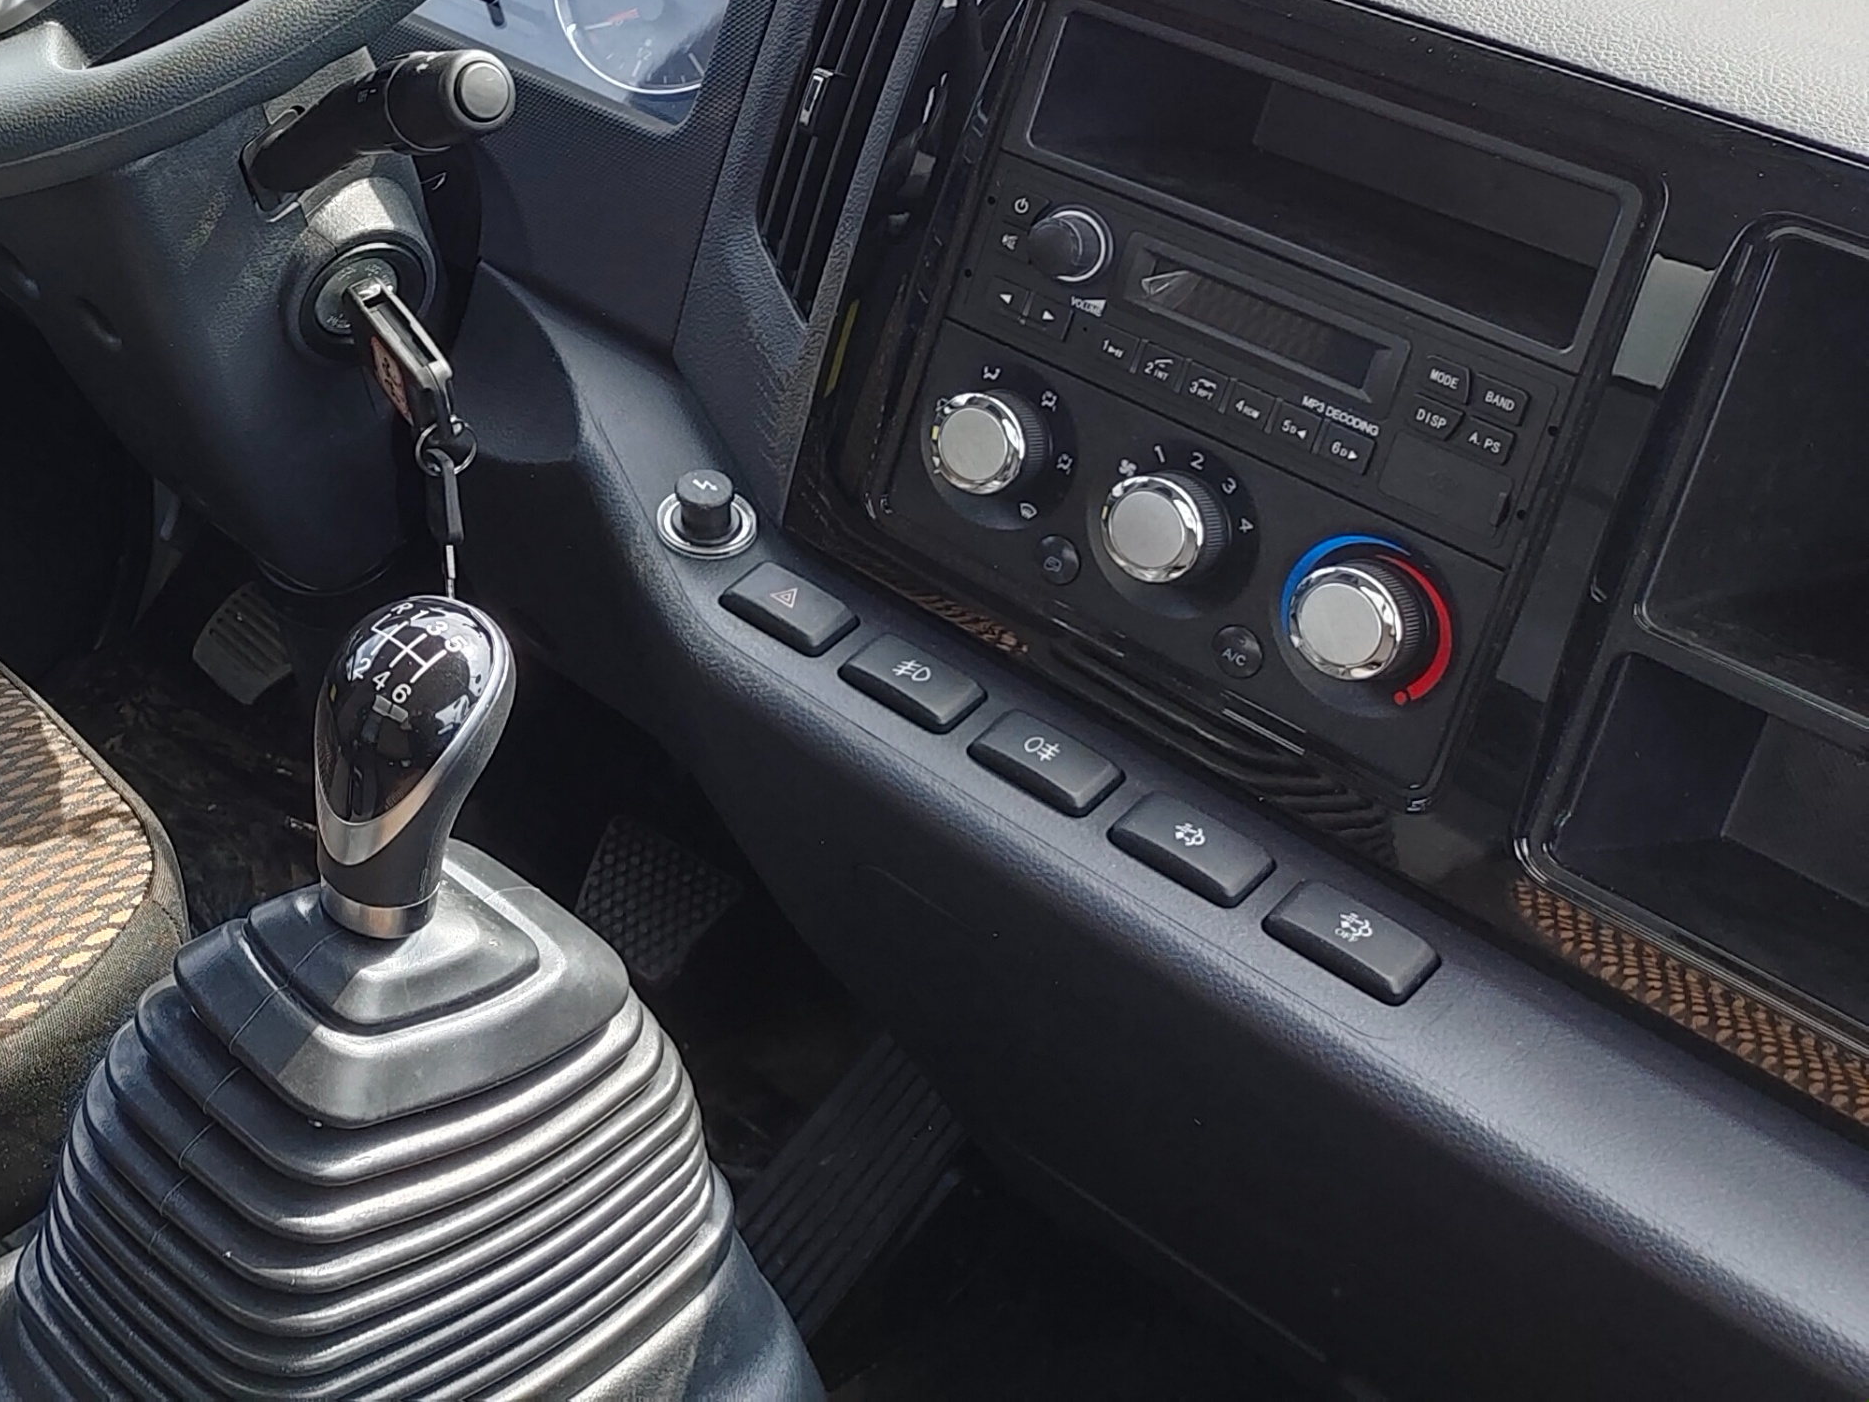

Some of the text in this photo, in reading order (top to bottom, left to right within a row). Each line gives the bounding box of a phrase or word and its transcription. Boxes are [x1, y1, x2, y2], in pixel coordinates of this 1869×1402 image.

[1071, 296, 1102, 317] VOLUME
[1144, 362, 1170, 381] 2 INT
[1430, 368, 1459, 390] MODE
[1188, 380, 1198, 394] 3
[1235, 399, 1244, 413] 4
[1484, 390, 1515, 411] BAND
[1301, 395, 1379, 437] MP3 DECODING
[1416, 408, 1447, 429] DISP
[1154, 445, 1166, 463] 1
[1190, 452, 1205, 470] 2
[1221, 477, 1237, 494] 3
[1239, 518, 1254, 534] 4
[391, 602, 468, 652] R 1 3 5
[1222, 648, 1247, 667] A/C
[353, 658, 412, 704] 2 4 6
